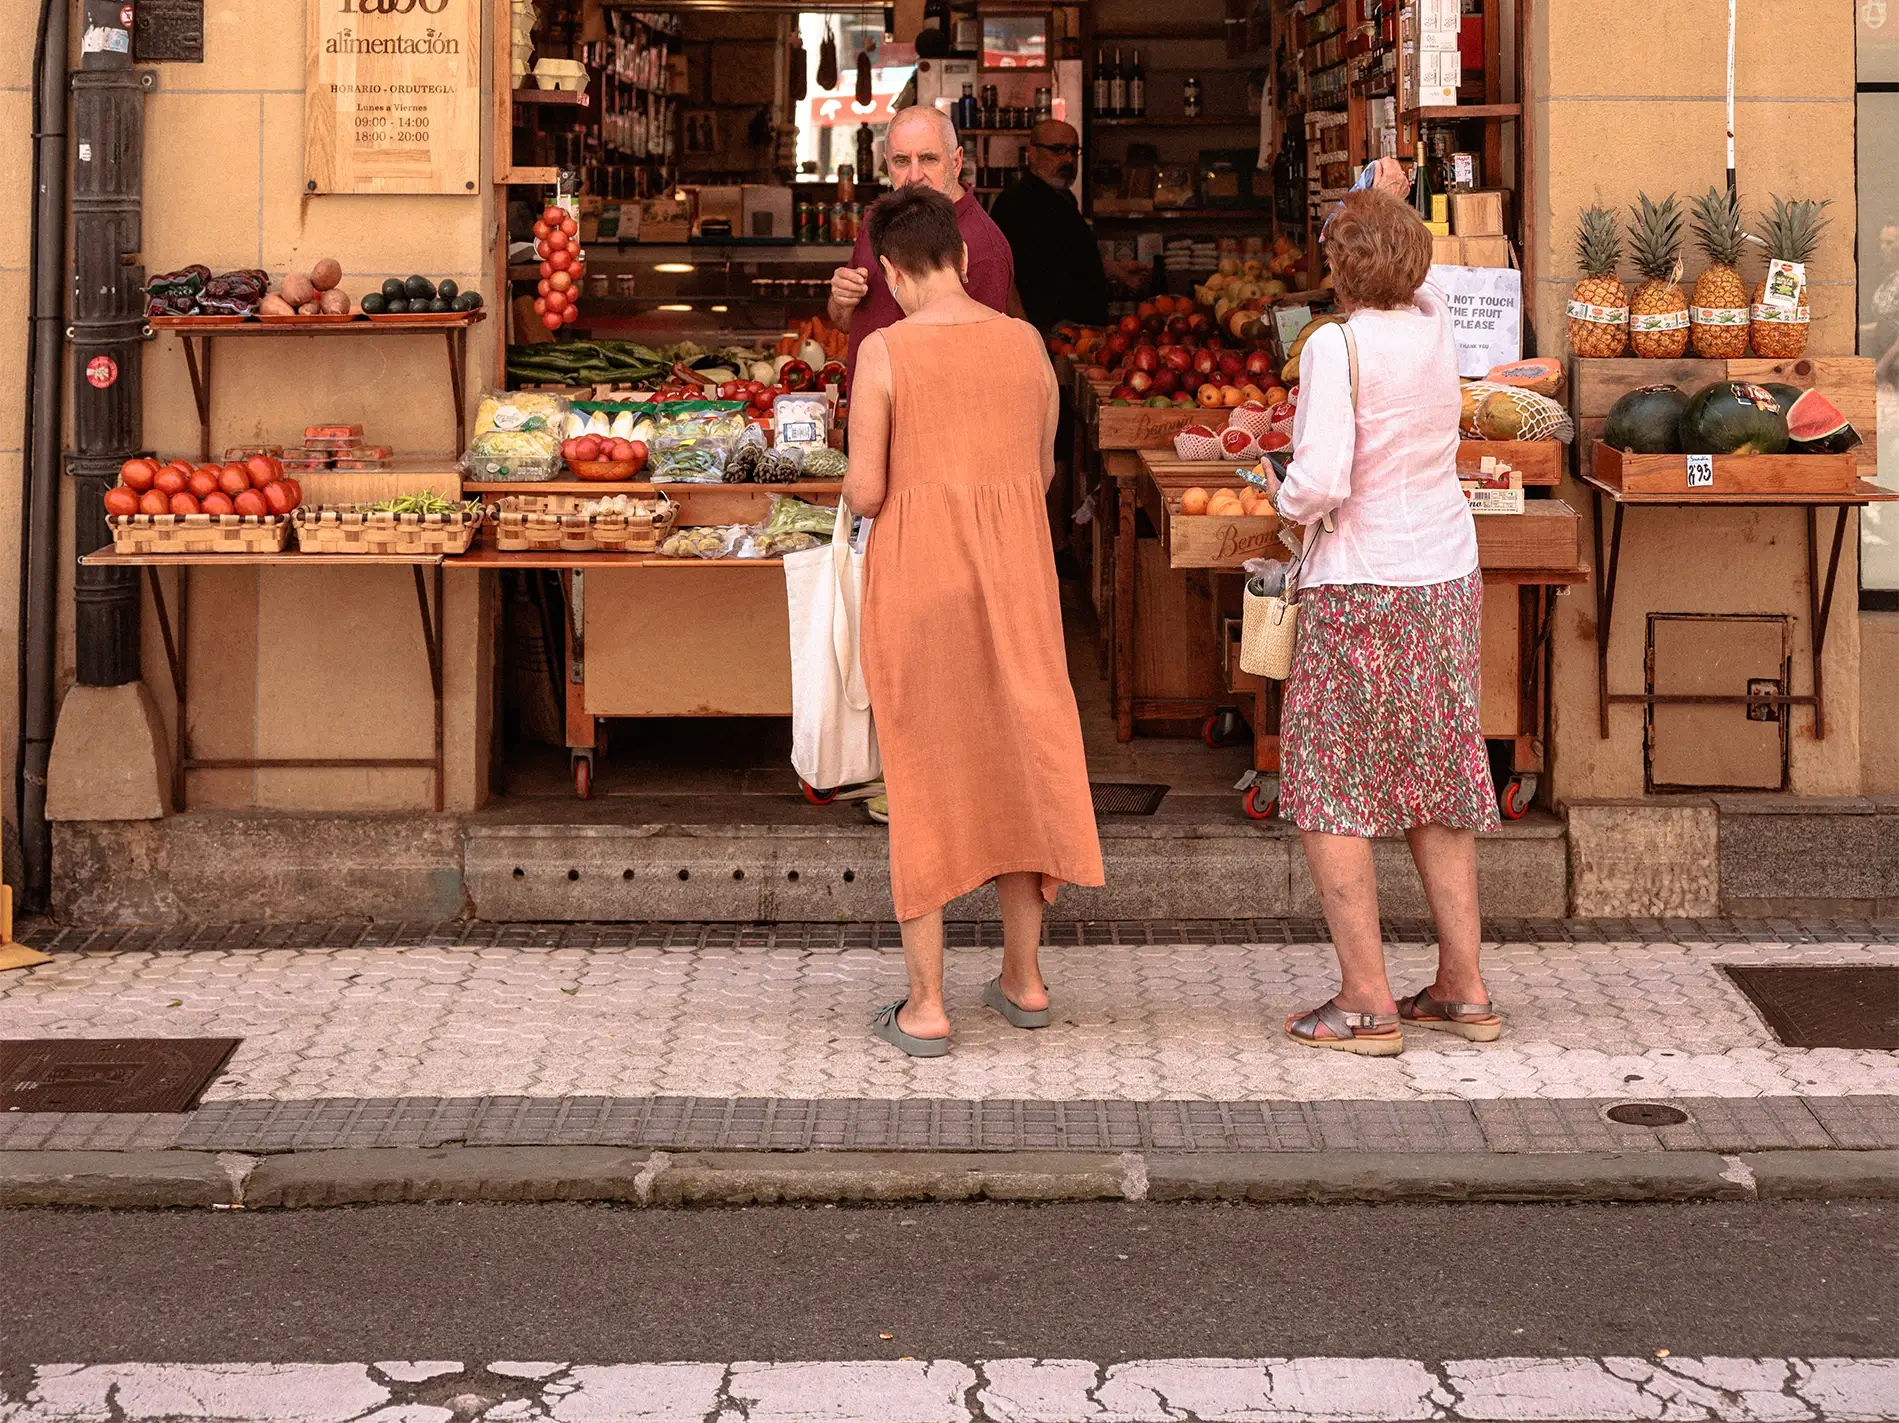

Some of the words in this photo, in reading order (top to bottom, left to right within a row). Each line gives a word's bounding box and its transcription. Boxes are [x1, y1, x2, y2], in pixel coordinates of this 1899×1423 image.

[326, 28, 460, 54] alimentación
[330, 84, 381, 94] HORARIO
[389, 84, 454, 94] ORDUTEGIA
[357, 103, 384, 112] Lunes
[393, 103, 428, 112] Viernes
[354, 117, 387, 128] 09:00
[399, 117, 430, 128] 14:00
[355, 131, 386, 142] 18:00
[397, 131, 430, 142] 20:00
[1453, 294, 1475, 305] NOT
[1479, 296, 1515, 307] TOUCH
[1448, 306, 1468, 317] THE
[1472, 308, 1503, 319] FRUIT
[1454, 319, 1495, 330] PLEASE
[1212, 524, 1276, 561] Beron
